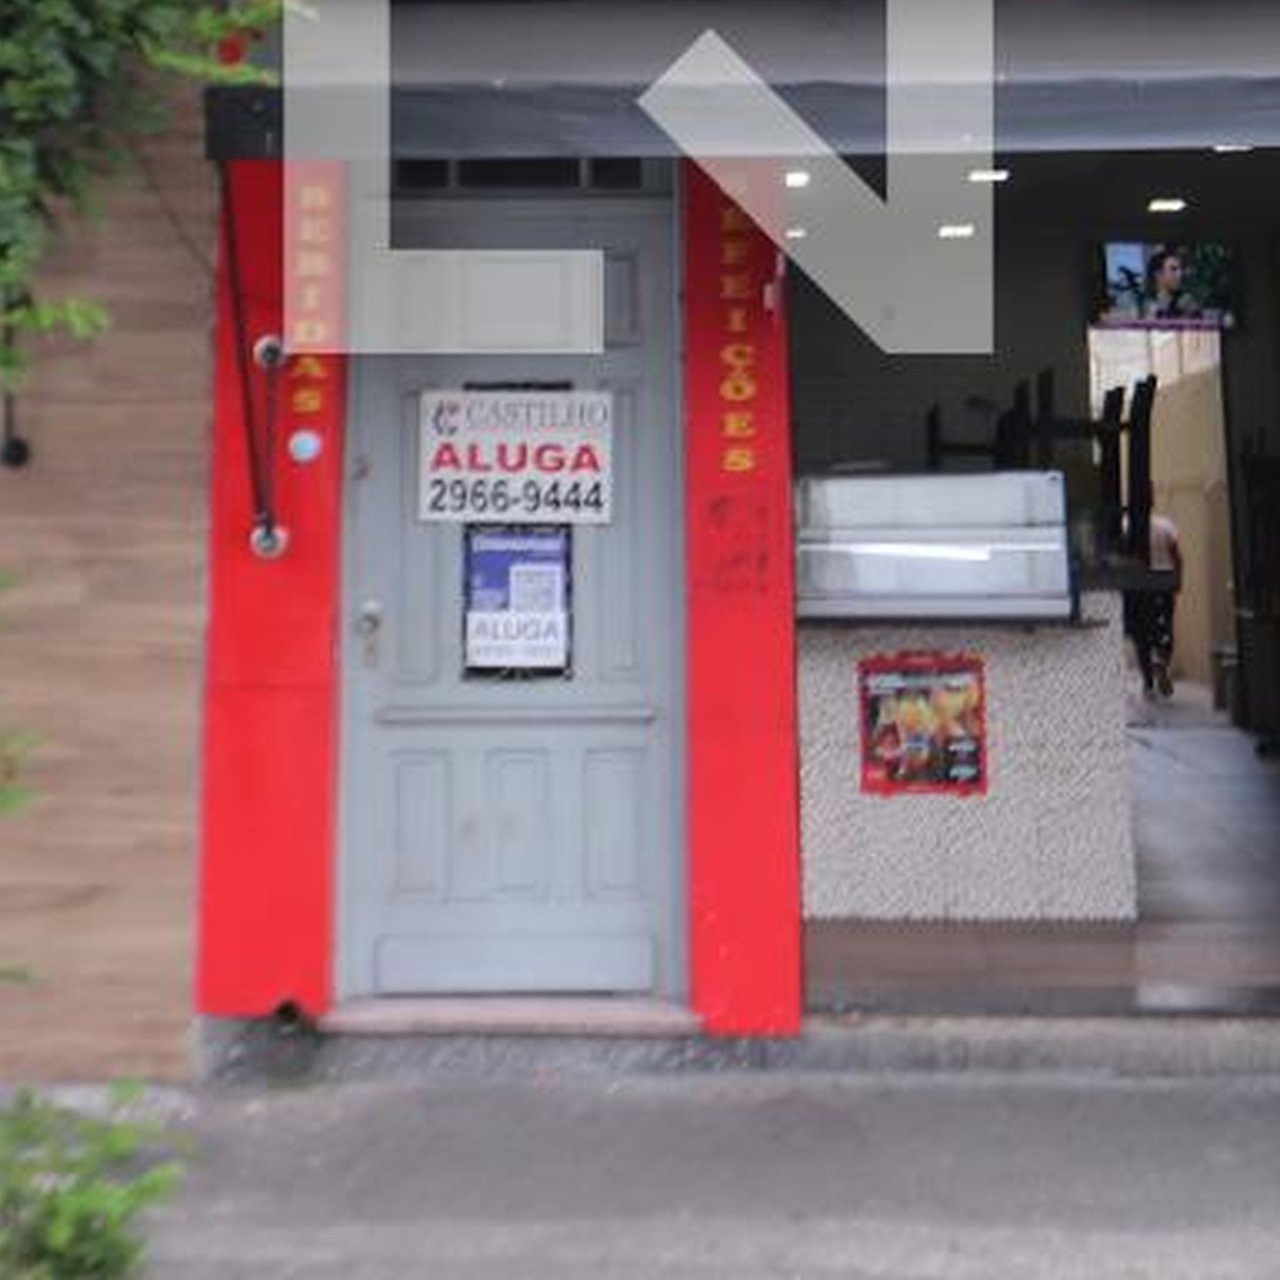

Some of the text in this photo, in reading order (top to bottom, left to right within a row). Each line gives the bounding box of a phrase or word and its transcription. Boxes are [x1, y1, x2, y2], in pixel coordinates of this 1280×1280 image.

[720, 171, 756, 472] EFEIÇÕES
[431, 441, 601, 474] ALUGA
[429, 478, 604, 513] 2966-9444
[472, 614, 560, 641] ALUGA
